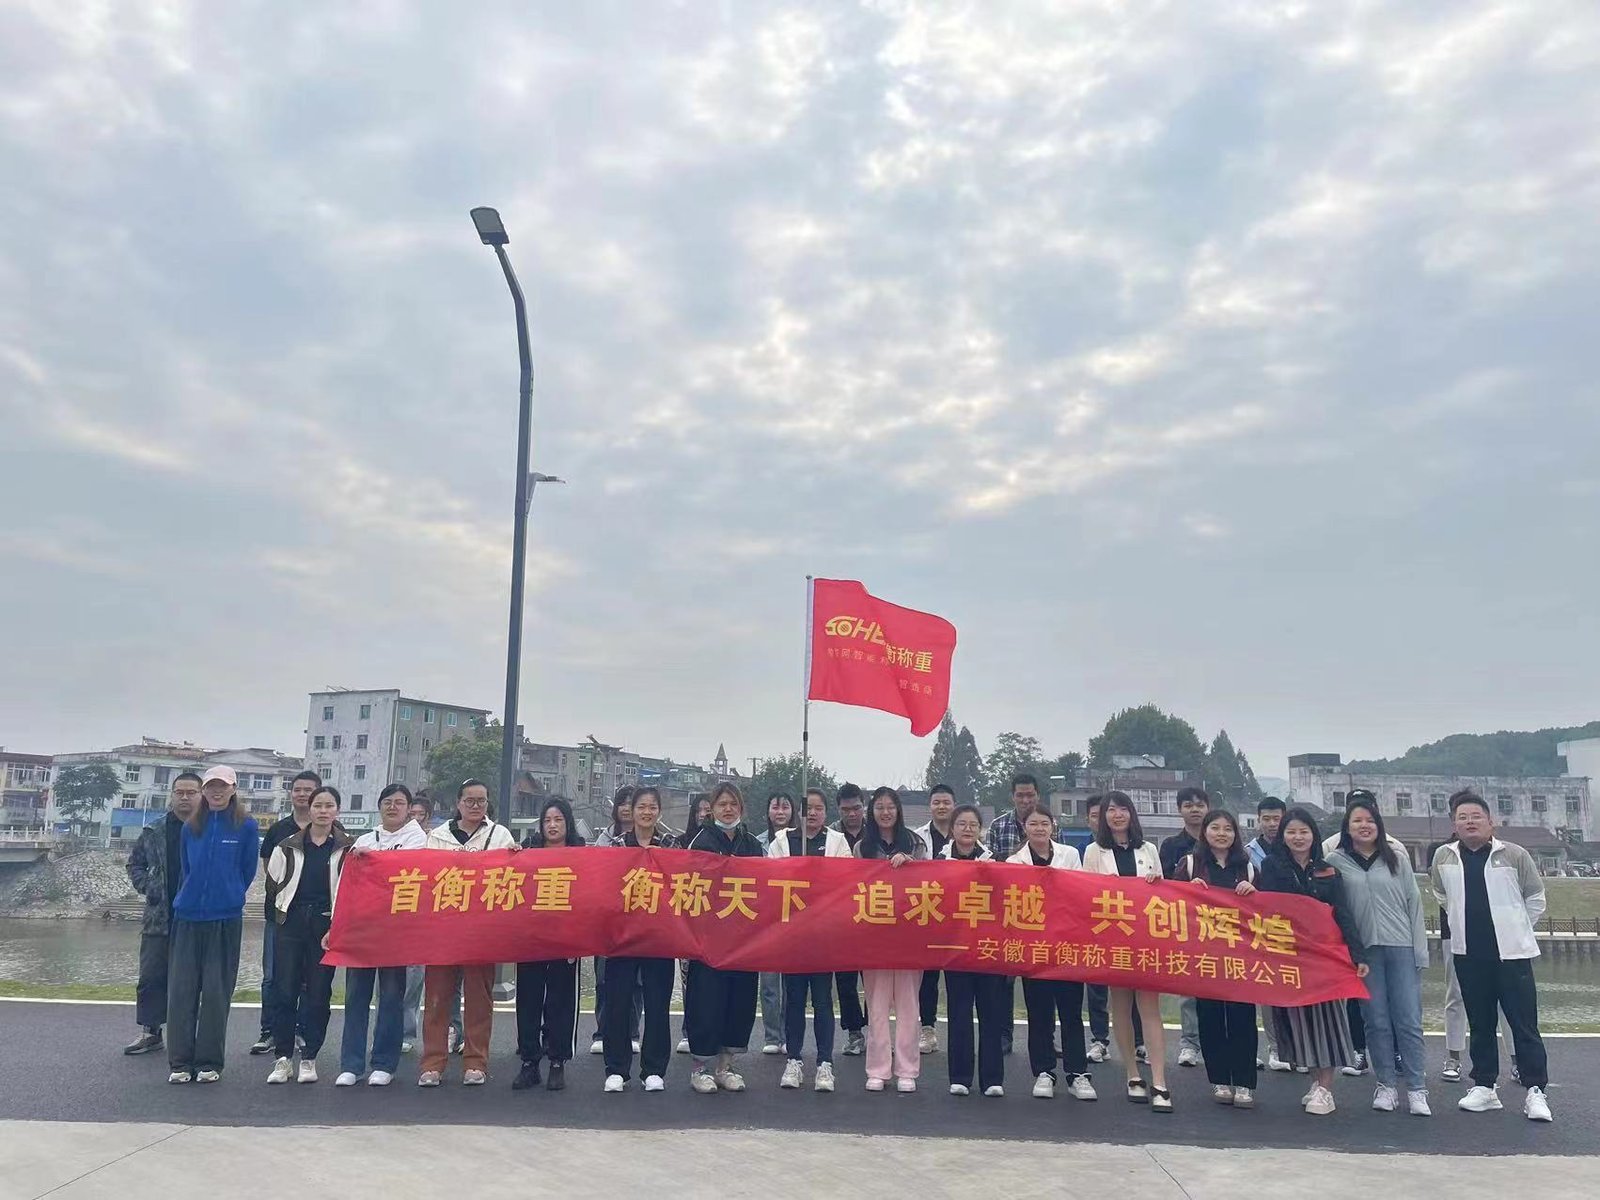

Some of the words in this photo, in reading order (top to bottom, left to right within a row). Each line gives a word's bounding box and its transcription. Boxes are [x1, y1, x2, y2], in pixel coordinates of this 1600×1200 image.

[388, 866, 578, 914] 首衡称重
[621, 866, 811, 923] 衡称天下
[852, 880, 1047, 932] 追求卓越
[1090, 890, 1297, 956] 共创辉煌
